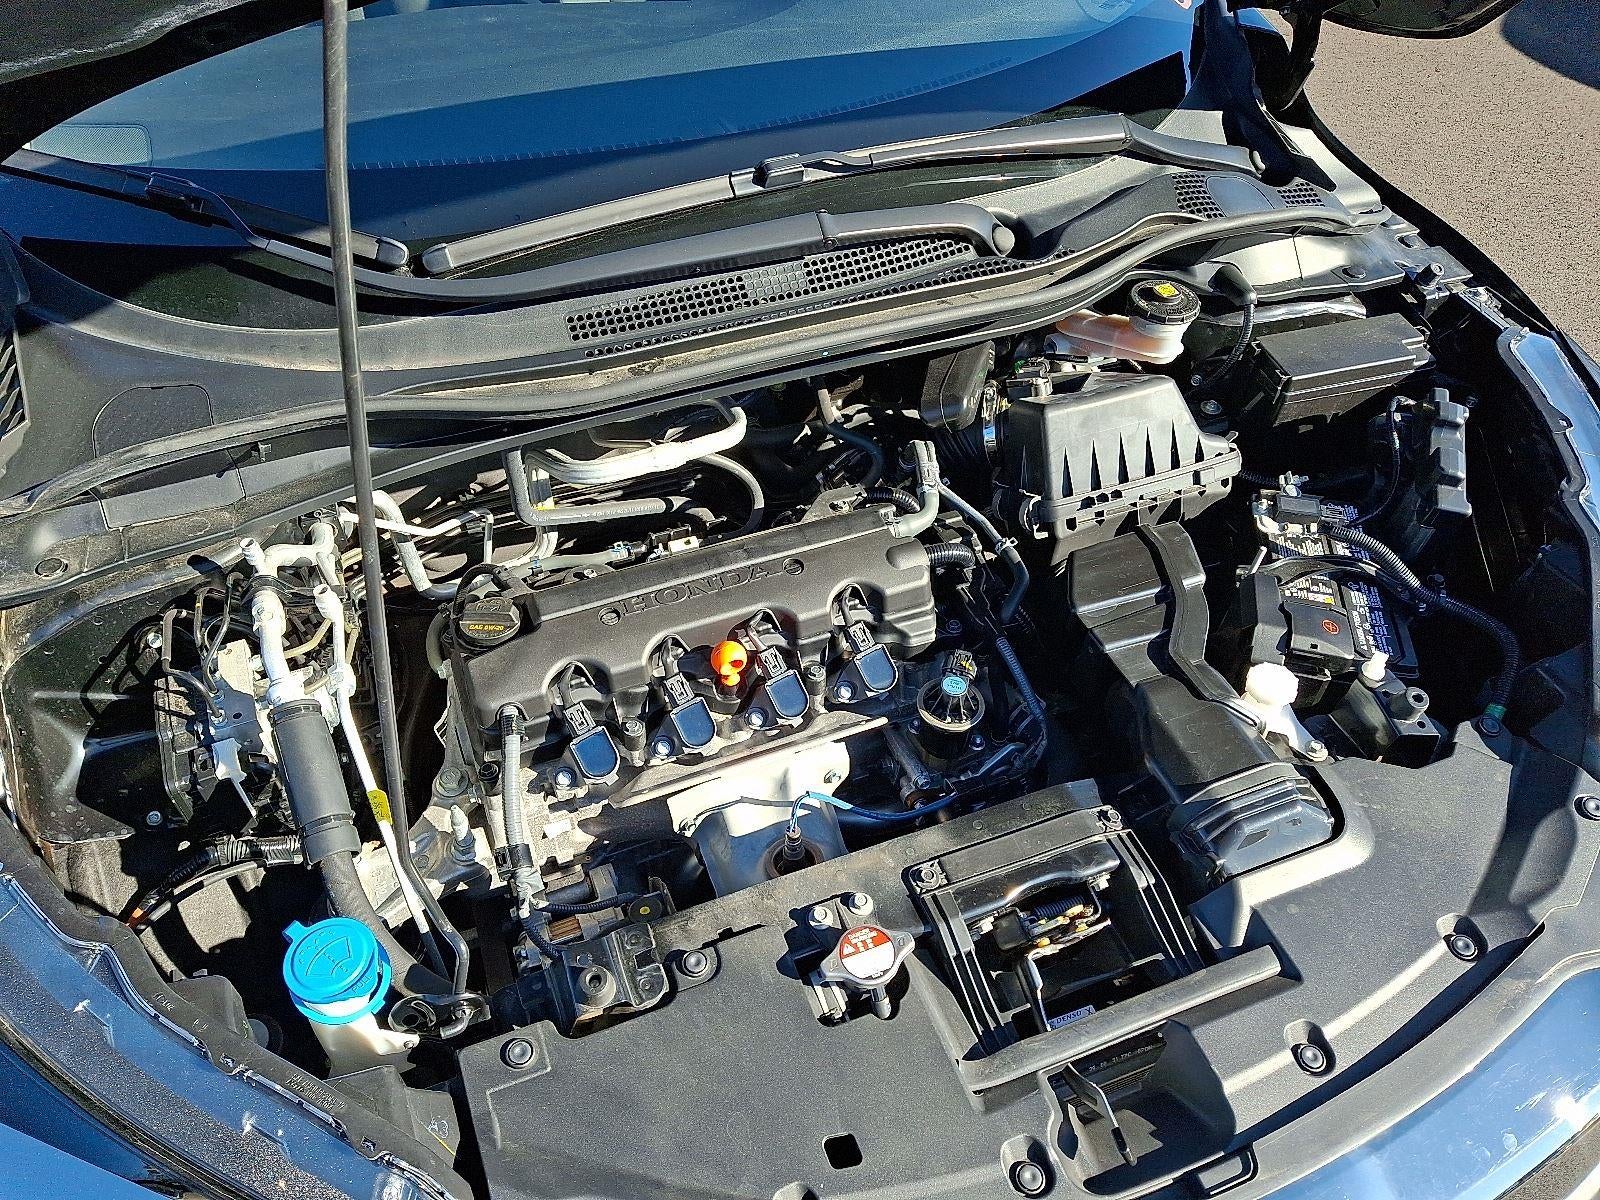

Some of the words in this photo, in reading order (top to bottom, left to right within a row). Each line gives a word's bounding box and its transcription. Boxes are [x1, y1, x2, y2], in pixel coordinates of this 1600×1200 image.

[621, 564, 783, 617] HONDA
[351, 975, 373, 994] PULL
[1056, 1010, 1082, 1024] DENSO
